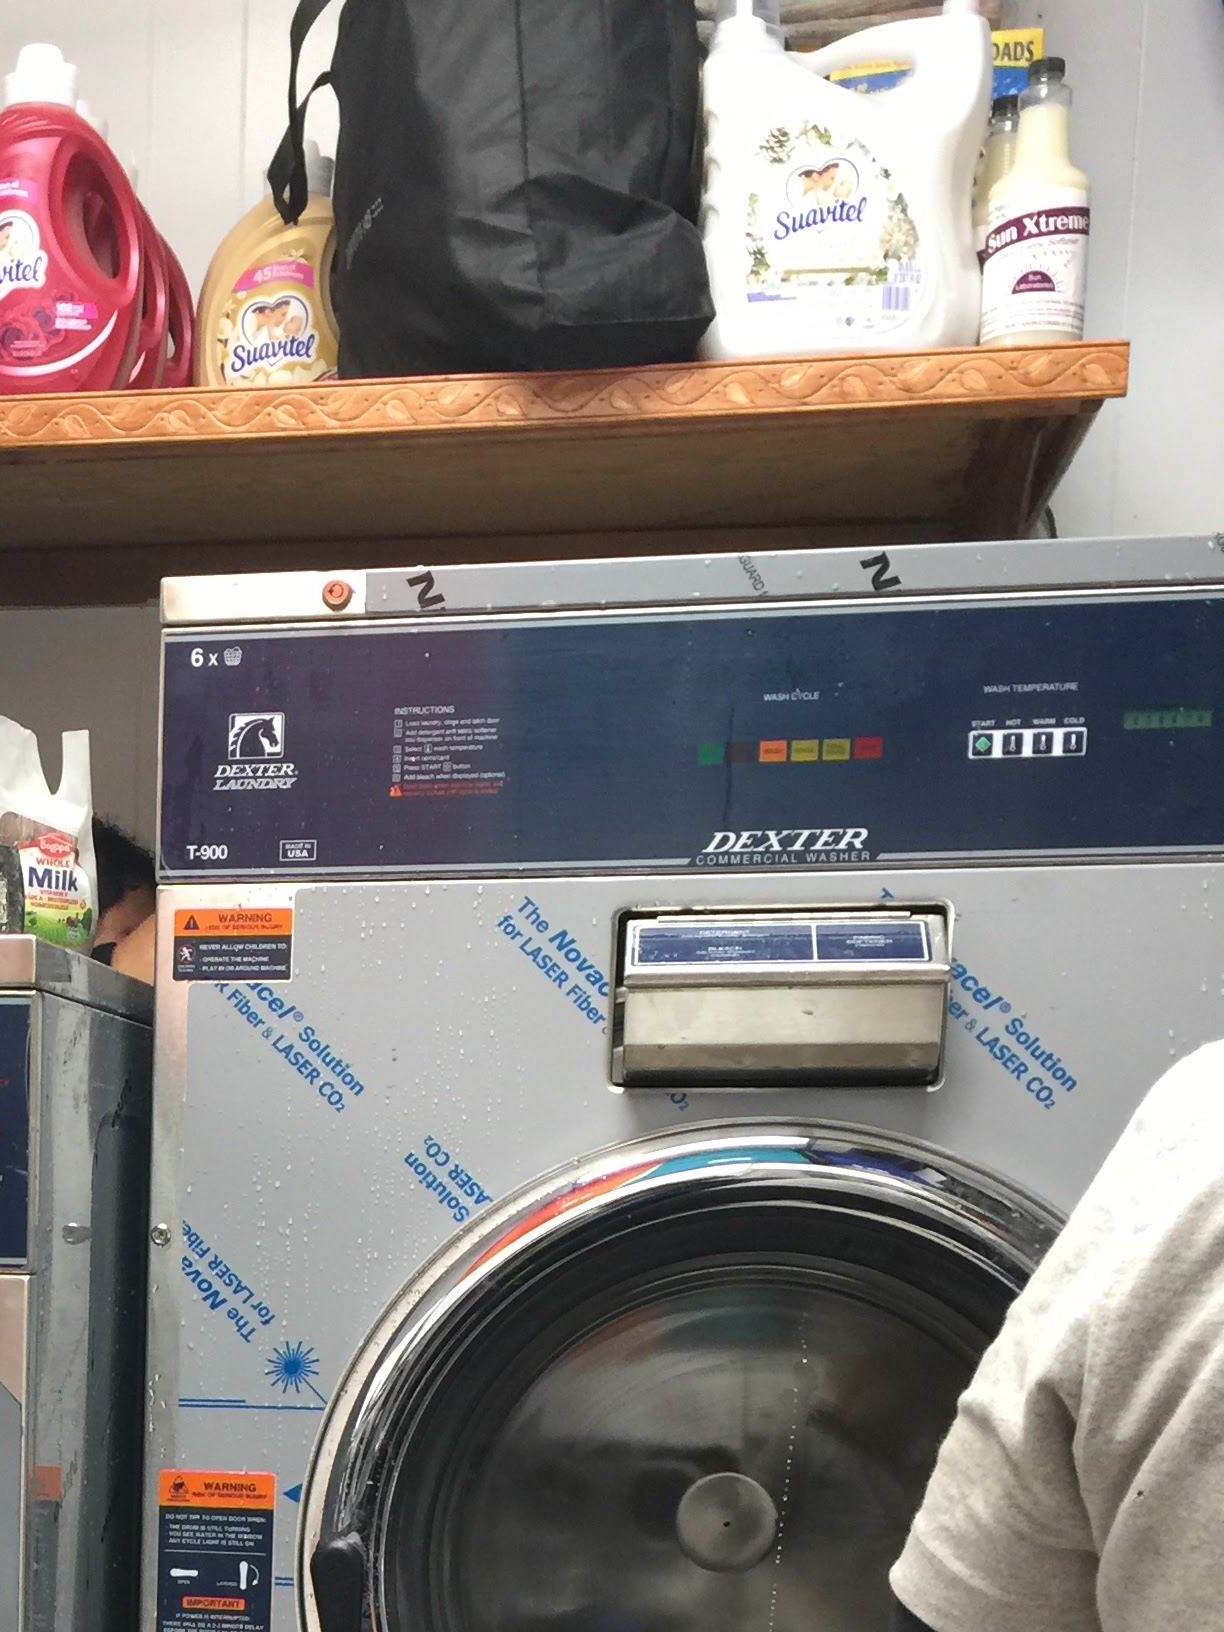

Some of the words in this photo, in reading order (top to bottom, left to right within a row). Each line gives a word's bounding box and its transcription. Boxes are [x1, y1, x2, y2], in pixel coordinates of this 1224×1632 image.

[773, 196, 867, 241] Suavitel
[987, 226, 1018, 254] Sun
[1022, 213, 1089, 236] Xtreme
[253, 267, 272, 283] 45
[230, 333, 316, 373] Suavitel
[740, 555, 765, 591] GUARD
[190, 647, 204, 667] 6
[763, 693, 790, 702] WASH
[983, 684, 1011, 694] WASH
[1012, 682, 1079, 693] TEMPERATURE
[394, 705, 455, 715] INSTRUCTIONS
[971, 719, 996, 727] START
[214, 763, 295, 778] DEXTER
[212, 777, 298, 791] LAUNDRY
[186, 844, 228, 860] T-900
[701, 827, 869, 853] DEXTER
[36, 857, 70, 868] WHOLE
[287, 849, 309, 858] USA
[696, 853, 798, 866] COMMERCIAL
[806, 851, 871, 863] WASHER
[28, 866, 79, 892] Milk
[218, 913, 273, 923] WARNING
[518, 895, 550, 934] The
[548, 929, 609, 998] Novac
[497, 915, 524, 940] for
[519, 936, 570, 990] LASER
[565, 983, 606, 1025] Fiber
[227, 988, 266, 1030] Fiber
[262, 1026, 274, 1039] &
[271, 1034, 321, 1086] LASER
[964, 1018, 978, 1032] &
[975, 1026, 1030, 1081] LASER
[298, 1025, 366, 1097] Solution
[1004, 1017, 1078, 1092] Solution
[404, 1152, 470, 1223] Solution
[449, 1167, 494, 1206] ASER
[182, 1220, 211, 1259] Fibe
[181, 1255, 228, 1311] Nova
[208, 1253, 255, 1305] LASER
[226, 1307, 257, 1343] The
[250, 1301, 276, 1326] for
[203, 1481, 257, 1493] WARNING
[186, 1598, 241, 1608] IMPORTANT
